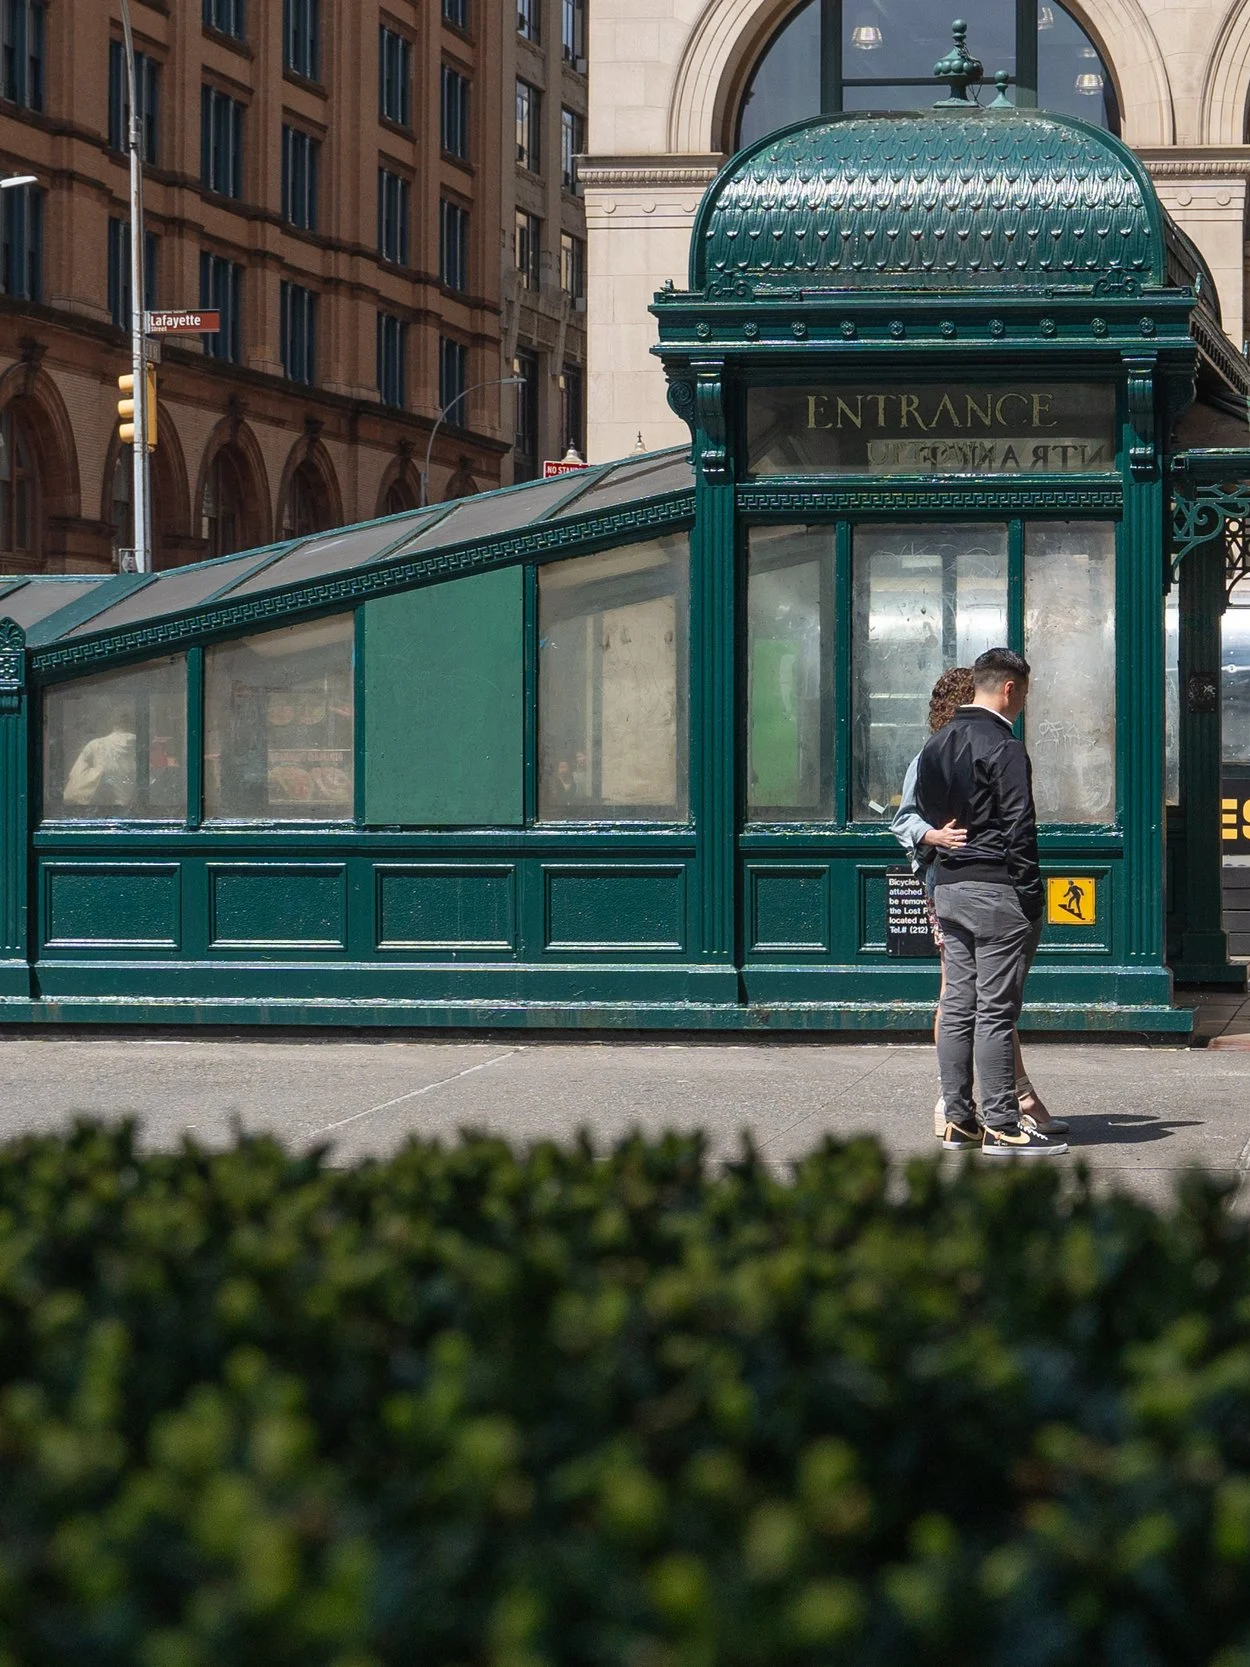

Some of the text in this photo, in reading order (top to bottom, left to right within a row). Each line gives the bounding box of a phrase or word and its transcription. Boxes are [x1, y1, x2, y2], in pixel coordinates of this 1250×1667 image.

[150, 314, 201, 329] Lafayette
[806, 393, 1058, 431] ENTRANCE
[547, 465, 557, 474] NO
[889, 878, 920, 887] Bicycles
[889, 888, 922, 896] attached
[889, 897, 899, 905] be
[904, 907, 921, 915] Lost
[889, 916, 918, 924] located
[909, 925, 928, 934] (212)
